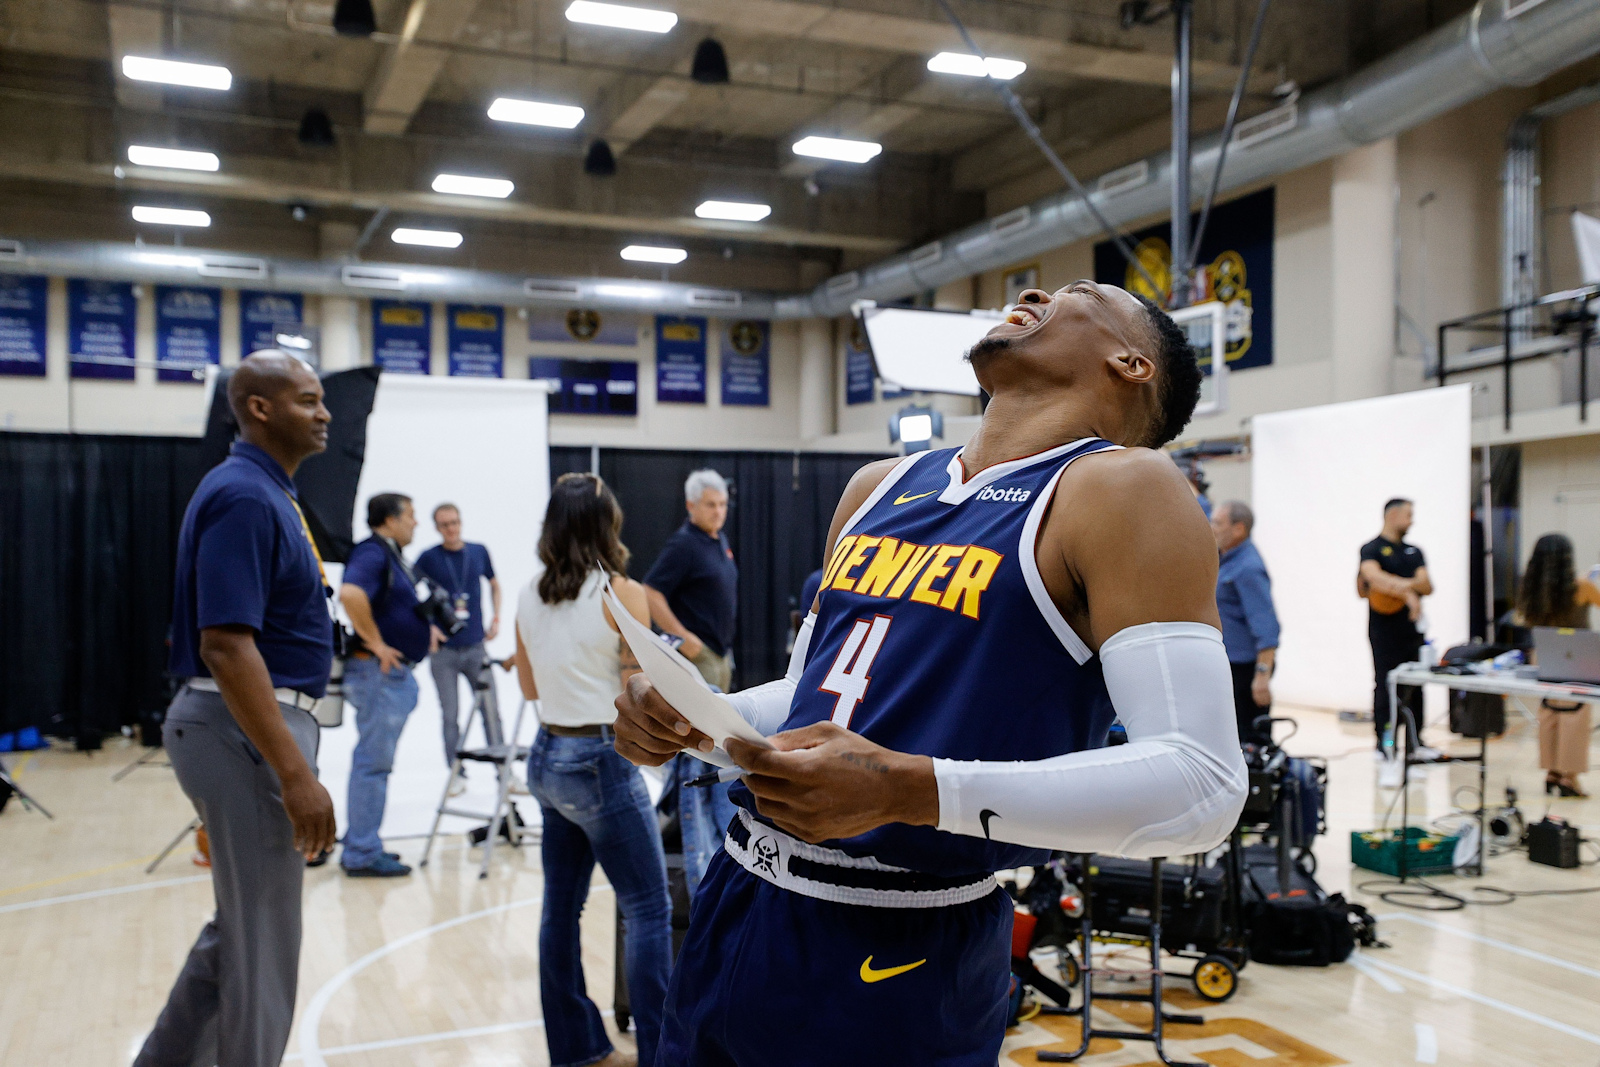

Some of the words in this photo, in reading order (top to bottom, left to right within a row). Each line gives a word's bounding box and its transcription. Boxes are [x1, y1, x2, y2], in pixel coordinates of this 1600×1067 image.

[976, 485, 1031, 502] ibotta
[819, 533, 1005, 620] DENVER
[817, 613, 893, 730] 4
